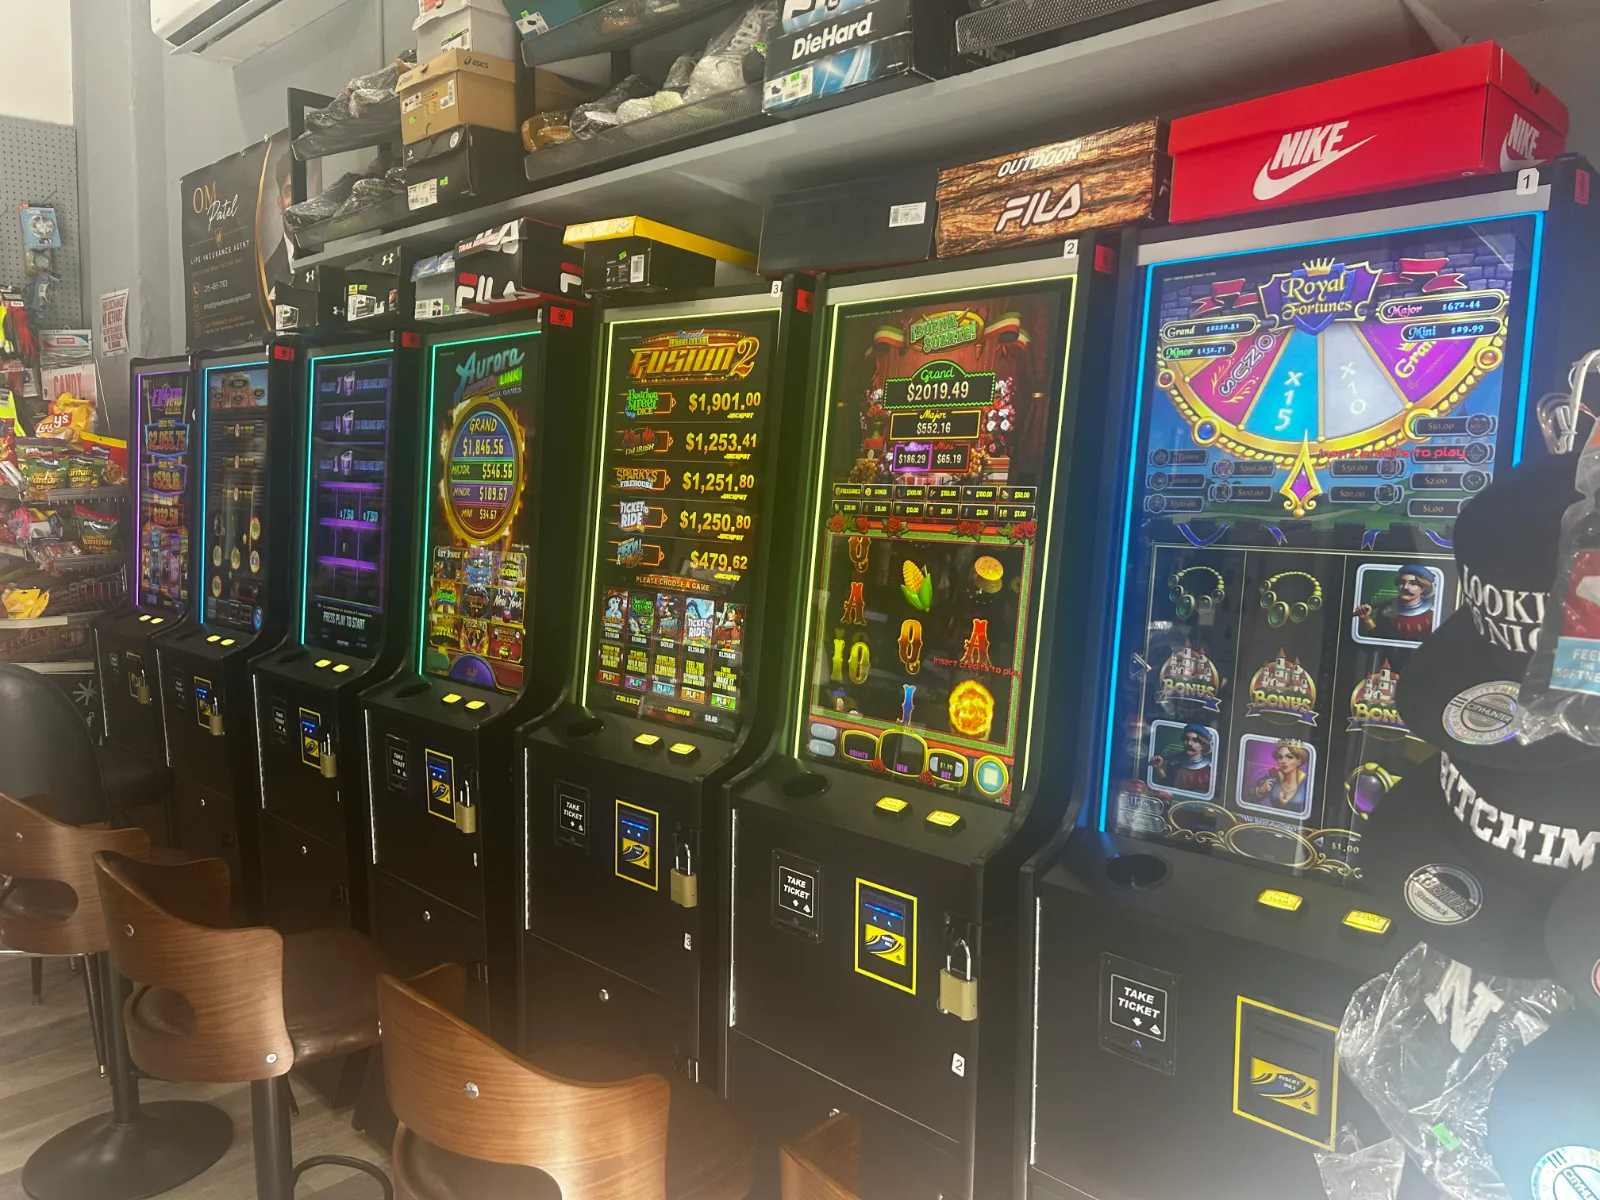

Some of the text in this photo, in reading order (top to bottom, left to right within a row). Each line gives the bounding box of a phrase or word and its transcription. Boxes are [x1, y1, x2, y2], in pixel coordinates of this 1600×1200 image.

[791, 12, 873, 60] DieHard
[1506, 113, 1540, 160] NIKE
[1271, 120, 1350, 171] NIKE
[997, 144, 1082, 178] OUTDOOR
[1523, 174, 1531, 189] 1
[193, 181, 216, 213] OM
[207, 194, 238, 231] Patel
[996, 182, 1082, 232] FILA
[1067, 243, 1075, 254] 2
[773, 284, 779, 294] 3
[1281, 271, 1347, 303] Royal
[1281, 301, 1352, 321] Fortunes
[1387, 305, 1423, 320] Major
[1167, 325, 1196, 338] Grand
[1408, 325, 1437, 341] Mini
[629, 346, 736, 380] FUSION
[730, 336, 760, 378] 2
[1165, 347, 1194, 359] Minor
[455, 347, 526, 396] Aurora
[500, 367, 520, 386] LINK
[920, 366, 955, 383] Grand
[53, 373, 82, 399] CANDY
[907, 380, 969, 403] $2019.49
[688, 391, 761, 415] $1,901.00
[637, 407, 653, 416] DICE
[919, 410, 947, 423] Major
[469, 417, 498, 434] GRAND
[916, 422, 951, 435] $552.16
[1427, 421, 1455, 430] $10.00
[685, 432, 757, 454] $1,253.41
[936, 454, 962, 465] $65.19
[1361, 446, 1410, 459] credits
[1414, 447, 1431, 458] to
[1433, 447, 1467, 460] play
[682, 471, 755, 494] $1,251.80
[1424, 476, 1448, 485] $2.00
[620, 501, 645, 514] TICKET
[1422, 504, 1444, 513] $1.00
[621, 512, 642, 528] RIDE
[679, 510, 751, 533] $1,250.80
[690, 550, 748, 572] $479.62
[636, 576, 658, 585] PLEASE
[659, 578, 684, 588] CHOOSE
[691, 582, 710, 591] GAME
[841, 582, 867, 626] A
[688, 626, 706, 637] RIDE
[616, 694, 641, 706] COLLECT
[716, 696, 731, 706] PLAY
[1163, 679, 1215, 699] BONUS
[1254, 690, 1312, 714] BONUS
[1466, 702, 1514, 724] CITYHUNTER
[566, 801, 580, 811] TAKE
[563, 808, 583, 821] TICKET
[1331, 841, 1360, 854] $1.00
[787, 875, 807, 888] TAKE
[783, 884, 810, 900] TICKET
[1124, 986, 1155, 1005] TAKE
[1117, 997, 1161, 1019] TICKET
[954, 1059, 964, 1071] 2
[1278, 1074, 1300, 1086] INSERT
[1283, 1082, 1297, 1091] BILL
